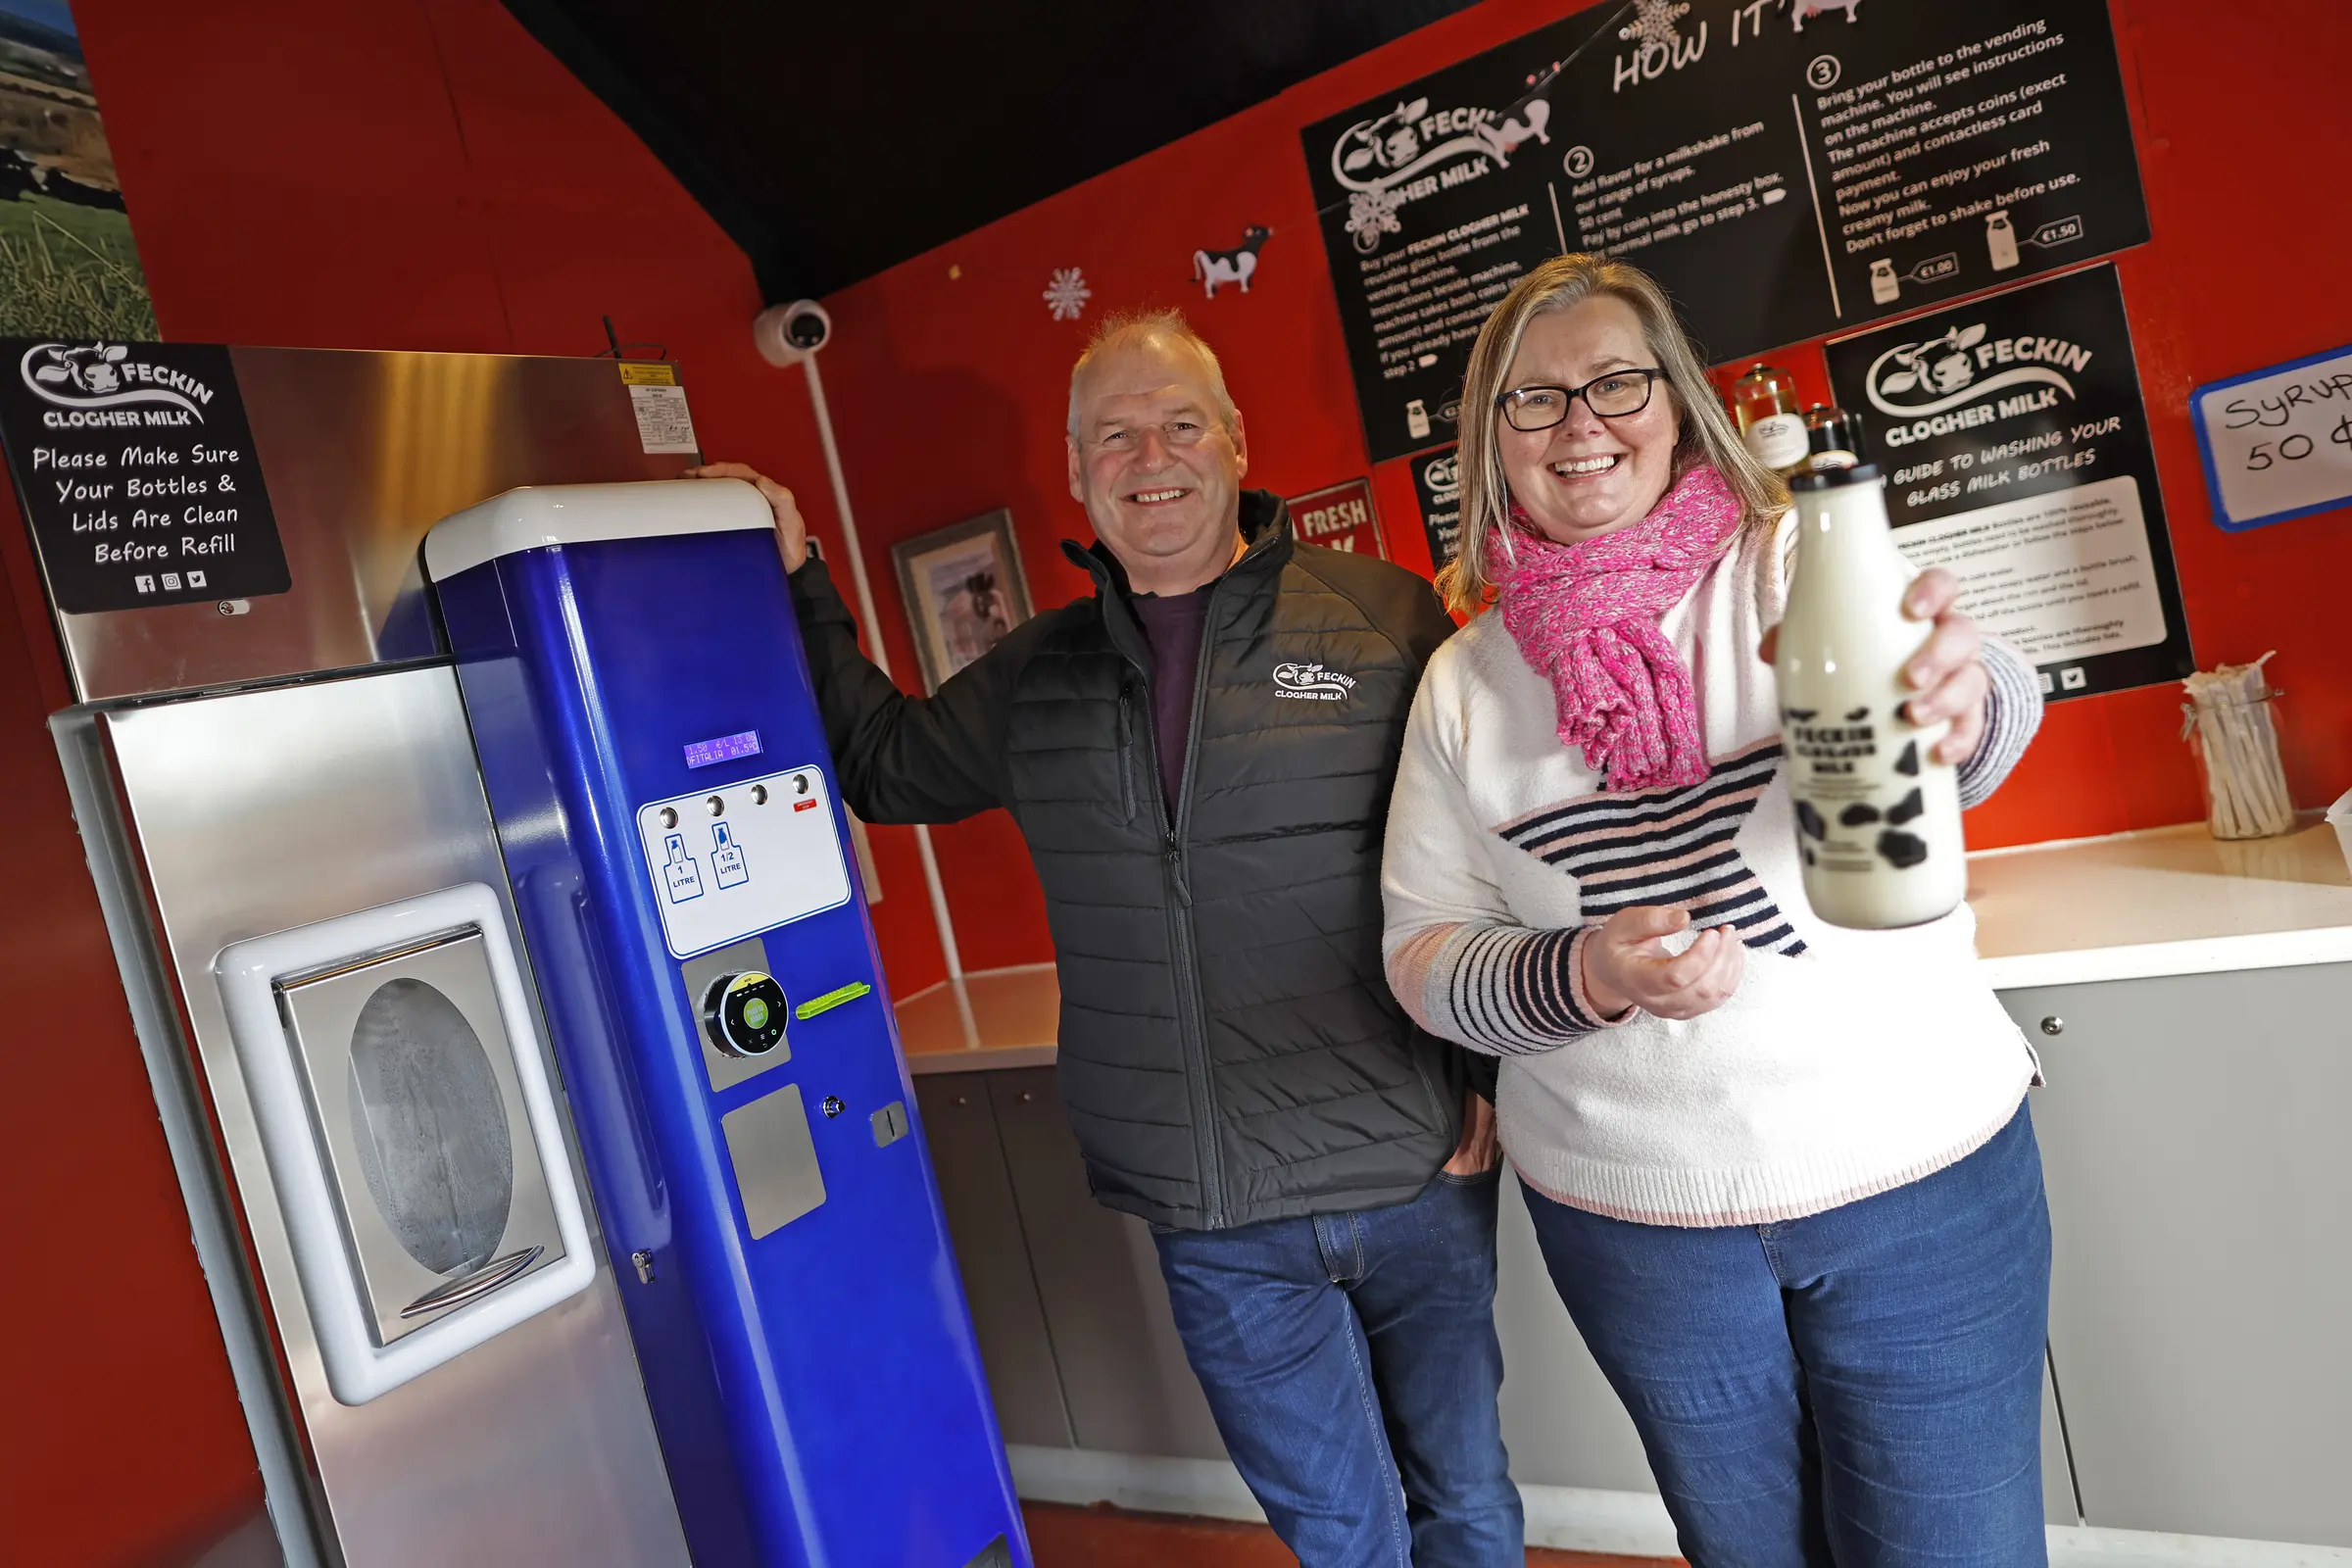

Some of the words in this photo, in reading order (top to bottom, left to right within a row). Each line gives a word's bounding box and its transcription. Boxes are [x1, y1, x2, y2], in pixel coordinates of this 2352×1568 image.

[1613, 20, 1707, 93] HOW
[1732, 0, 1772, 46] IT
[1815, 62, 1833, 83] 3
[1816, 86, 1856, 111] Bring
[1856, 75, 1890, 99] your
[1891, 60, 1936, 84] bottle
[1936, 52, 1955, 69] to
[1956, 41, 1983, 61] the
[1984, 18, 2048, 50] vending
[1820, 100, 1886, 129] machine.
[1886, 86, 1915, 106] You
[1915, 74, 1942, 95] will
[1943, 66, 1971, 84] see
[1972, 31, 2066, 75] instructions
[1419, 107, 1496, 142] FECK
[1824, 131, 1844, 147] on
[1844, 122, 1870, 140] the
[1871, 100, 1938, 131] machine.
[1826, 145, 1856, 165] The
[1855, 123, 1918, 155] machine
[1919, 103, 1977, 134] accepts
[1977, 90, 2018, 114] coins
[2019, 73, 2068, 101] (exect
[1634, 160, 1655, 176] for
[1654, 157, 1665, 170] a
[1665, 133, 1731, 166] milkshake
[1731, 121, 1764, 141] from
[1832, 153, 1892, 183] amount)
[1892, 142, 1922, 163] and
[1923, 114, 2007, 151] contactless
[2008, 100, 2043, 123] card
[1441, 155, 1490, 189] MILK
[1573, 151, 1588, 172] 2
[1838, 199, 1871, 219] Now
[1872, 188, 1901, 210] you
[1902, 180, 1929, 197] can
[1930, 165, 1972, 190] enjoy
[1972, 155, 2008, 180] your
[2009, 139, 2051, 163] fresh
[1574, 199, 1596, 216] our
[1597, 186, 1635, 208] range
[1634, 177, 1649, 194] of
[1835, 170, 1902, 203] payment.
[1594, 206, 1624, 226] cent
[1605, 225, 1622, 242] by
[1622, 217, 1650, 234] coin
[1649, 207, 1678, 224] into
[1677, 199, 1700, 216] the
[1699, 181, 1753, 208] honesty
[1652, 221, 1682, 243] milk
[1682, 218, 1700, 236] go
[1699, 212, 1716, 227] to
[1715, 202, 1746, 222] step
[1841, 210, 1894, 237] creamy
[1896, 198, 1933, 220] milk.
[1845, 231, 1885, 254] Don't
[1885, 220, 1930, 245] forget
[1930, 213, 1948, 228] to
[1948, 198, 1993, 222] shake
[1994, 182, 2046, 209] before
[2046, 172, 2082, 190] use.
[1471, 232, 1500, 250] from
[1499, 225, 1521, 241] the
[2040, 222, 2078, 243] €1.50
[1975, 335, 2093, 373] FECKIN
[120, 363, 214, 405] FECKIN
[43, 411, 141, 427] CLOGHER
[145, 410, 191, 425] MILK
[1885, 403, 1996, 448] CLOGHER
[1998, 387, 2059, 420] MILK
[32, 447, 108, 471] Please
[121, 446, 179, 466] Make
[191, 443, 240, 465] Sure
[1892, 459, 1945, 487] GUIDE
[1949, 451, 1975, 471] TO
[1980, 429, 2063, 466] WASHING
[2069, 416, 2122, 443] YOUR
[2246, 434, 2314, 470] 50
[55, 479, 114, 503] Your
[126, 475, 208, 498] Bottles
[218, 474, 236, 492] &
[1906, 480, 1961, 508] GLASS
[1966, 469, 2011, 494] MILK
[2017, 447, 2097, 482] BOTTLES
[73, 510, 119, 533] Lids
[131, 509, 172, 528] Are
[183, 506, 238, 524] Clean
[1302, 498, 1368, 538] FRESH
[94, 542, 170, 564] Before
[181, 533, 235, 557] Refill
[1275, 690, 1318, 700] CLOGHER
[1320, 692, 1343, 701] MILK
[1317, 671, 1356, 689] FECKIN
[686, 750, 723, 766] DFITALIA
[689, 743, 708, 755] 1.50
[677, 865, 683, 874] 1
[720, 852, 735, 862] 1/2
[720, 862, 742, 875] LITRE
[672, 875, 696, 889] LITRE
